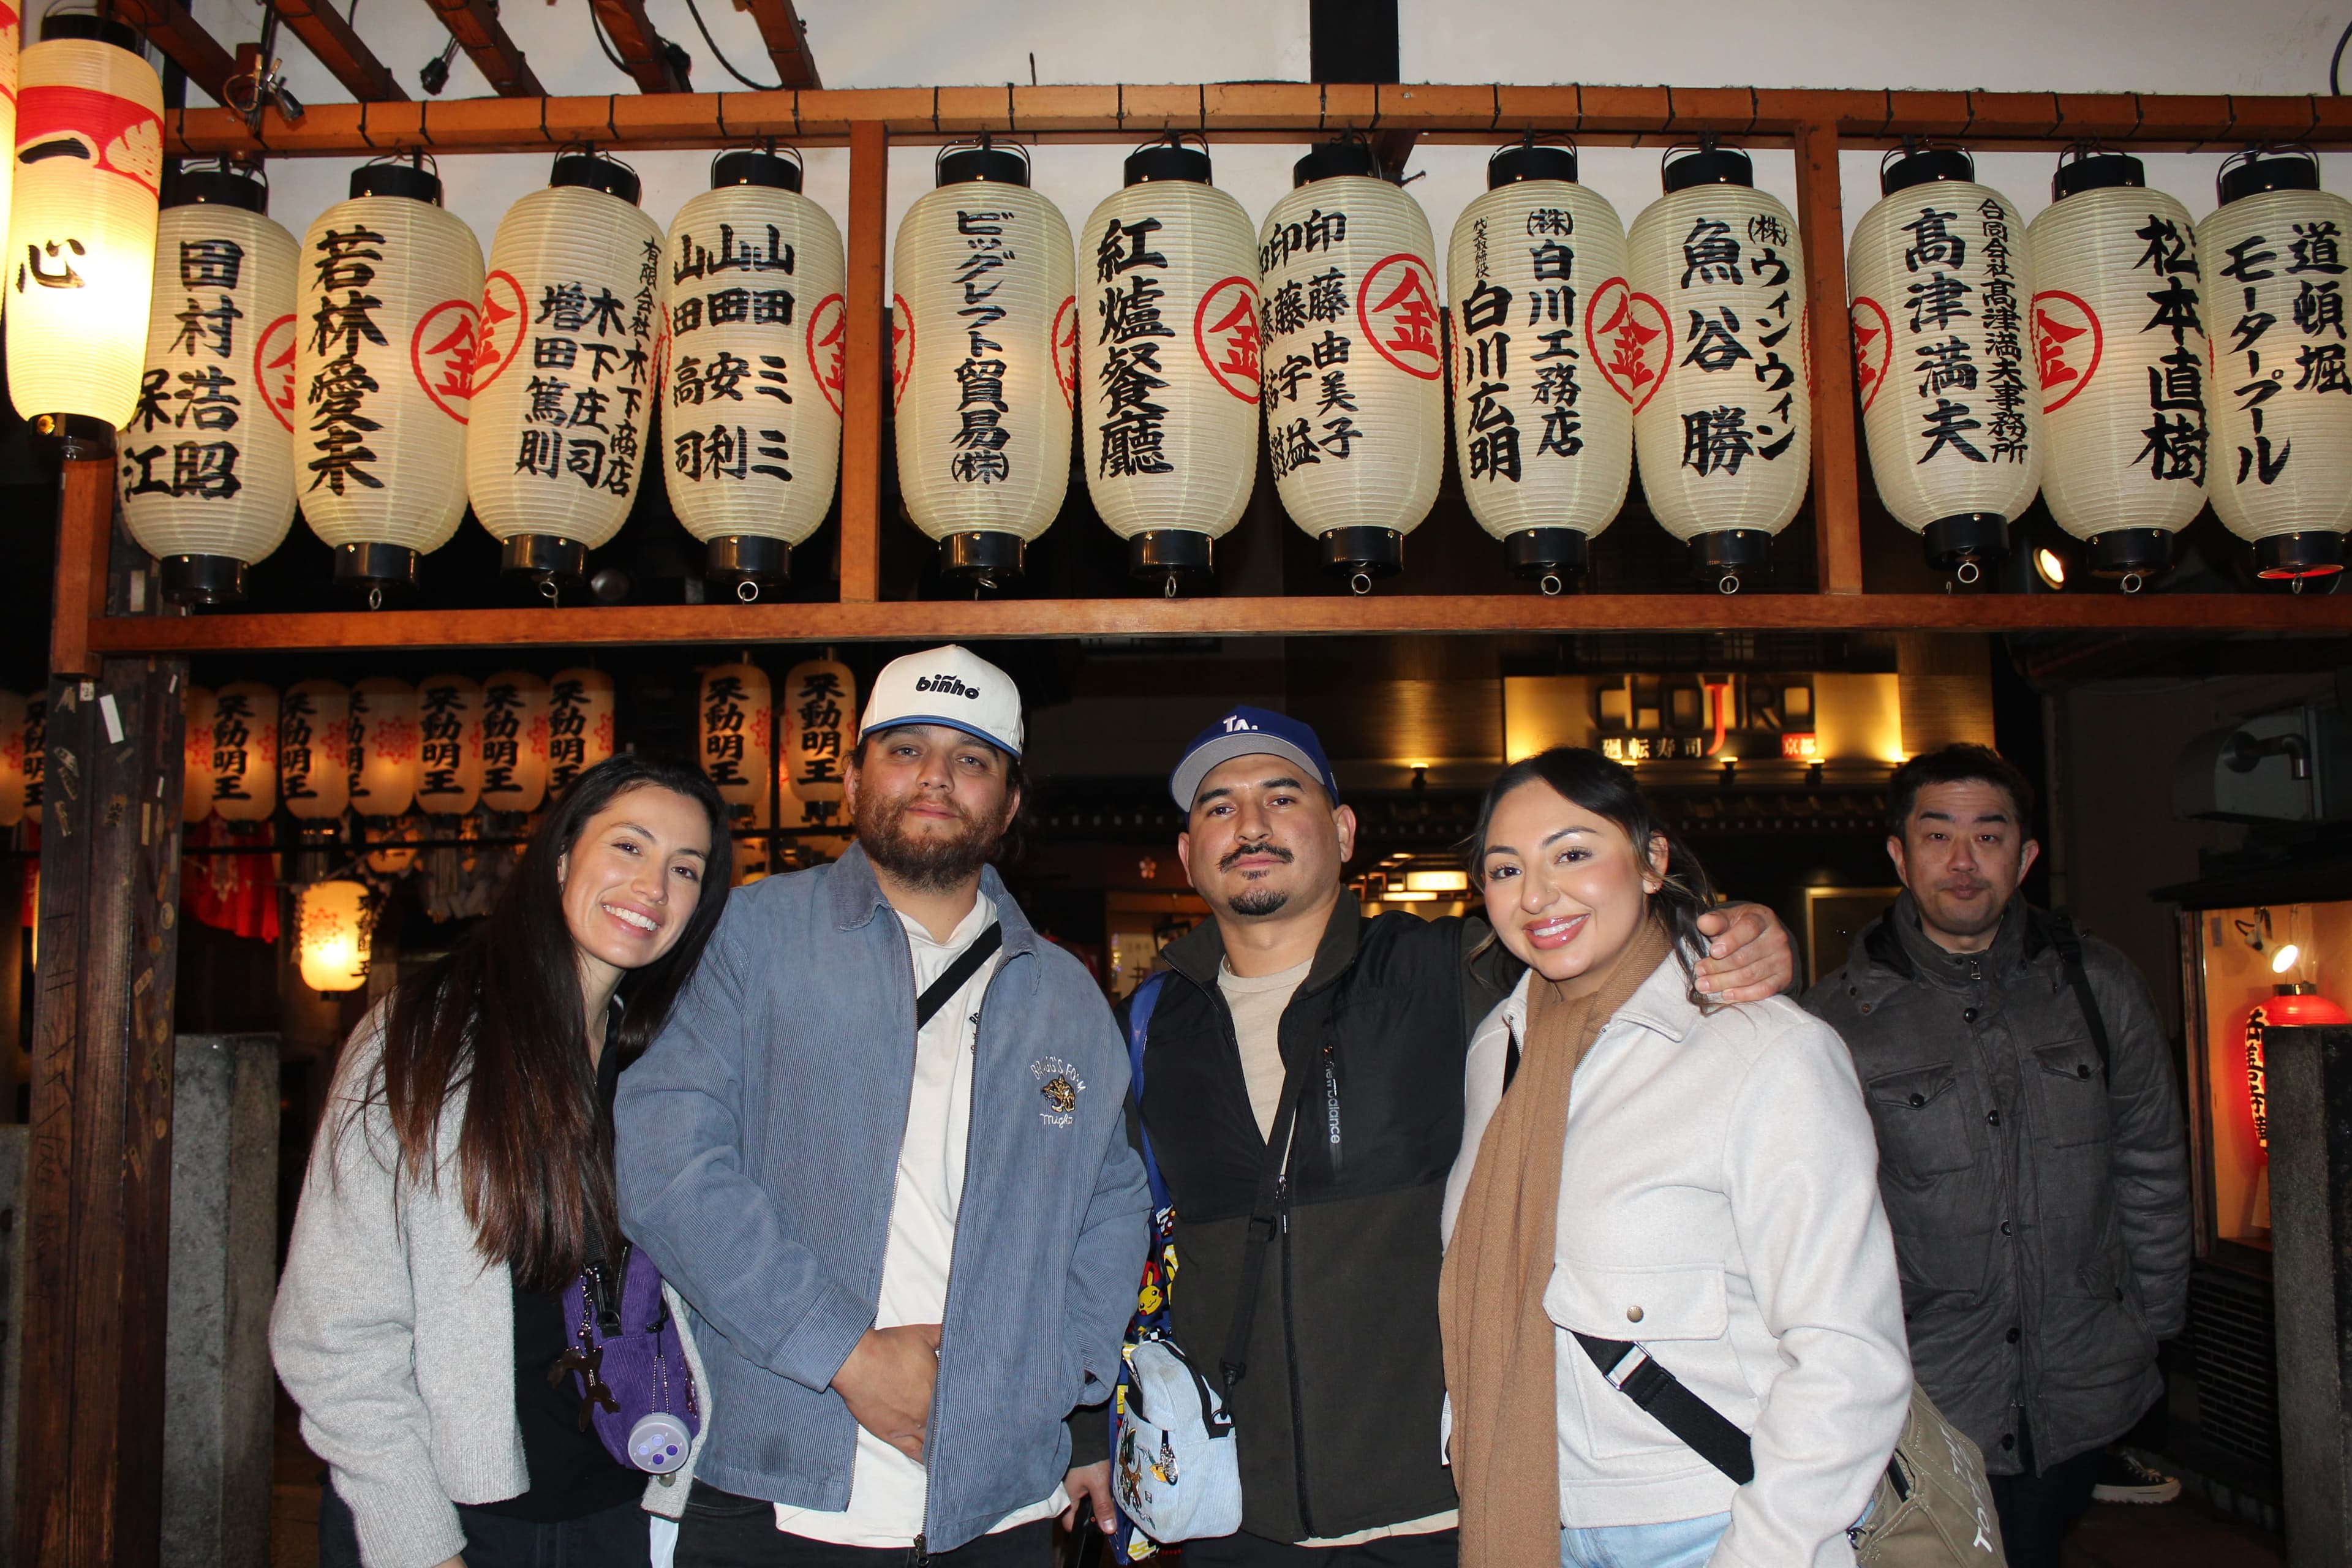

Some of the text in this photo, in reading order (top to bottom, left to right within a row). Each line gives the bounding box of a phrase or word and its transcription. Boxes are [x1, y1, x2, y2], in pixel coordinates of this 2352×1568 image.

[168, 239, 244, 500] 田村浩昭
[514, 281, 587, 480] 増田篤則
[566, 287, 626, 489] 木下庄司
[703, 224, 752, 481] 山田安利
[751, 224, 794, 481] 山田三三
[1303, 209, 1363, 461] 印藤由美子
[1372, 266, 1439, 362] 金
[1679, 218, 1755, 477] 魚谷勝
[2127, 214, 2209, 488] 松本直樹
[2220, 235, 2291, 485] モータープール
[2285, 221, 2352, 394] 道頓堀
